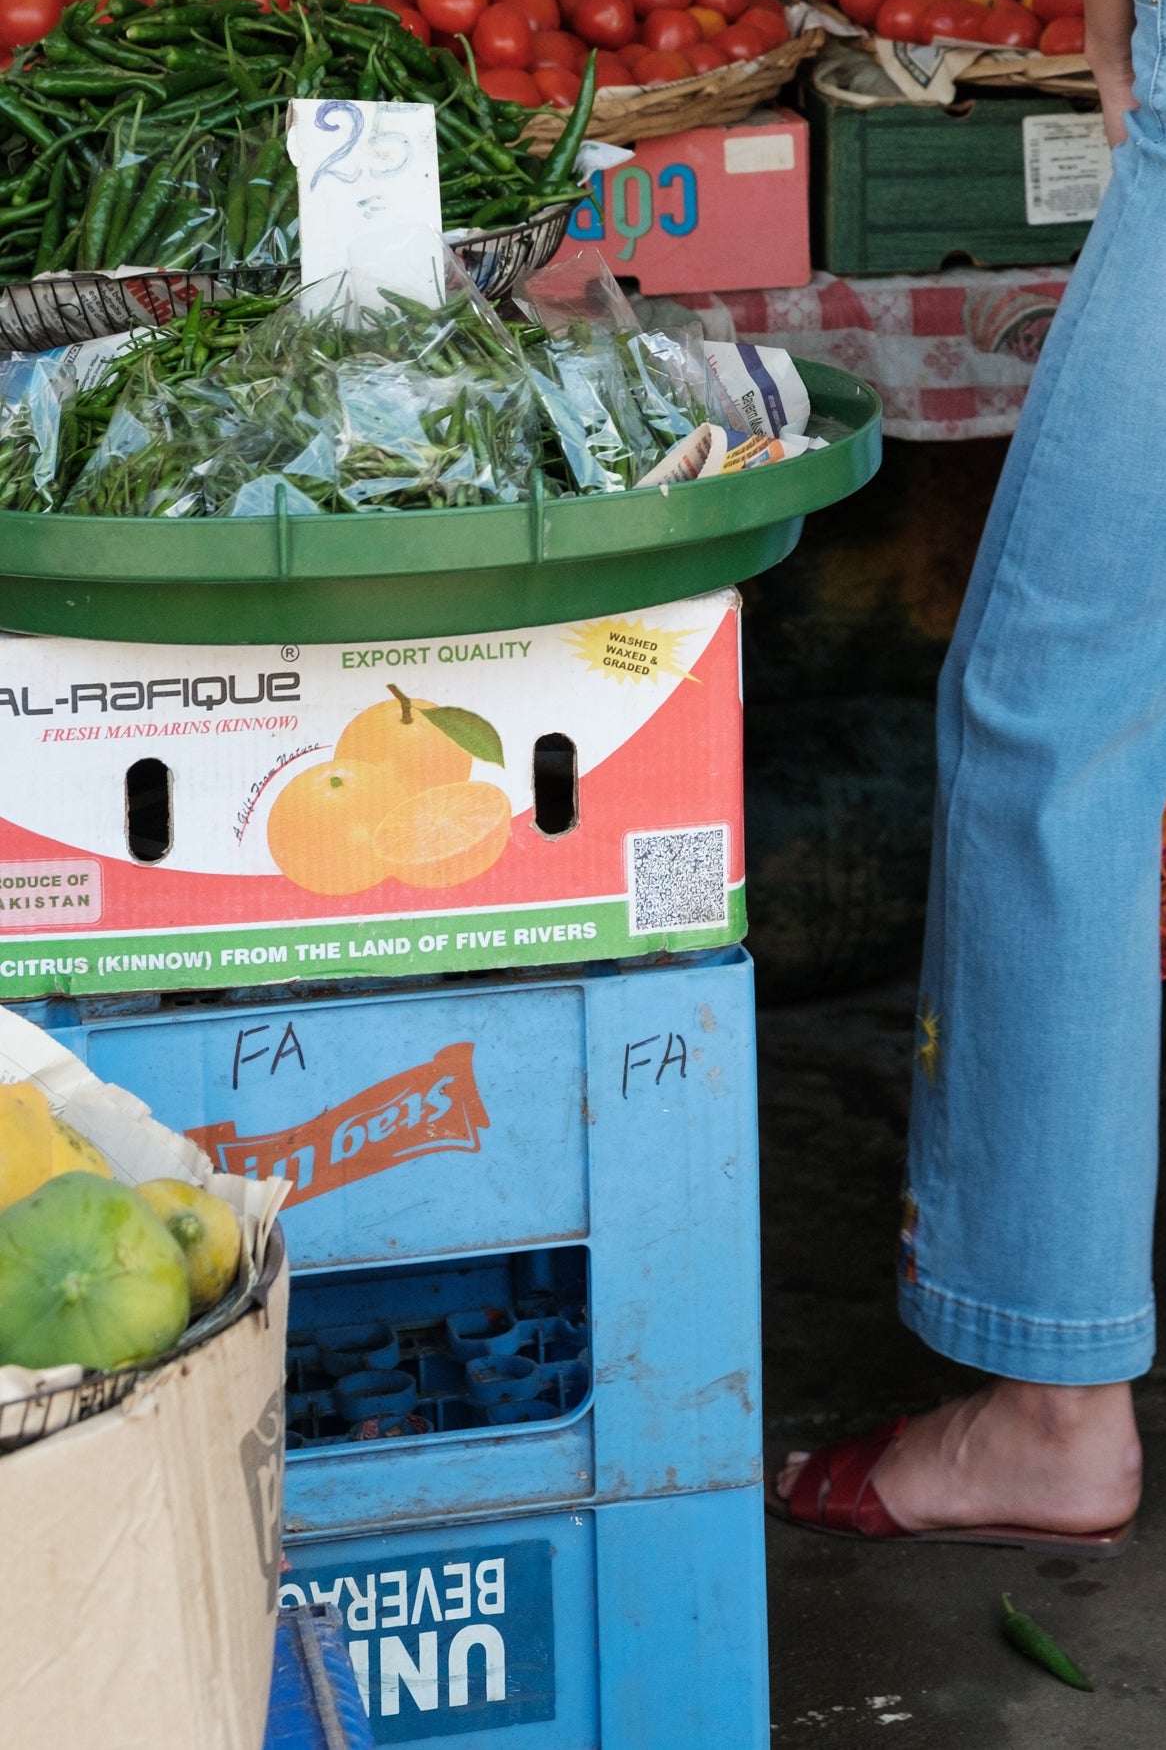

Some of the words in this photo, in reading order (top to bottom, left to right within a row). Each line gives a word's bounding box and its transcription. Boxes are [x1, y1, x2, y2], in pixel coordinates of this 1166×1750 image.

[310, 100, 423, 193] 25
[609, 632, 658, 651] WASHED
[341, 647, 431, 669] EXPORT
[437, 640, 532, 663] QUALITY
[603, 657, 650, 675] GRADED
[606, 644, 647, 662] WAXED
[650, 656, 658, 665] &
[41, 727, 100, 743] FRESH
[104, 720, 212, 739] MANDARINS
[215, 715, 298, 735] (KINNOW)
[276, 743, 319, 766] Nature
[0, 875, 62, 890] ODUCE
[67, 874, 89, 887] OF
[0, 957, 88, 978] CITRUS
[98, 951, 212, 976] (KINNOW)
[220, 945, 287, 966] FROM
[295, 942, 341, 961] THE
[349, 938, 411, 958] LAND
[418, 934, 449, 952] OF
[456, 930, 507, 950] FIVE
[514, 922, 597, 945] RIVERS
[231, 1020, 307, 1090] FA
